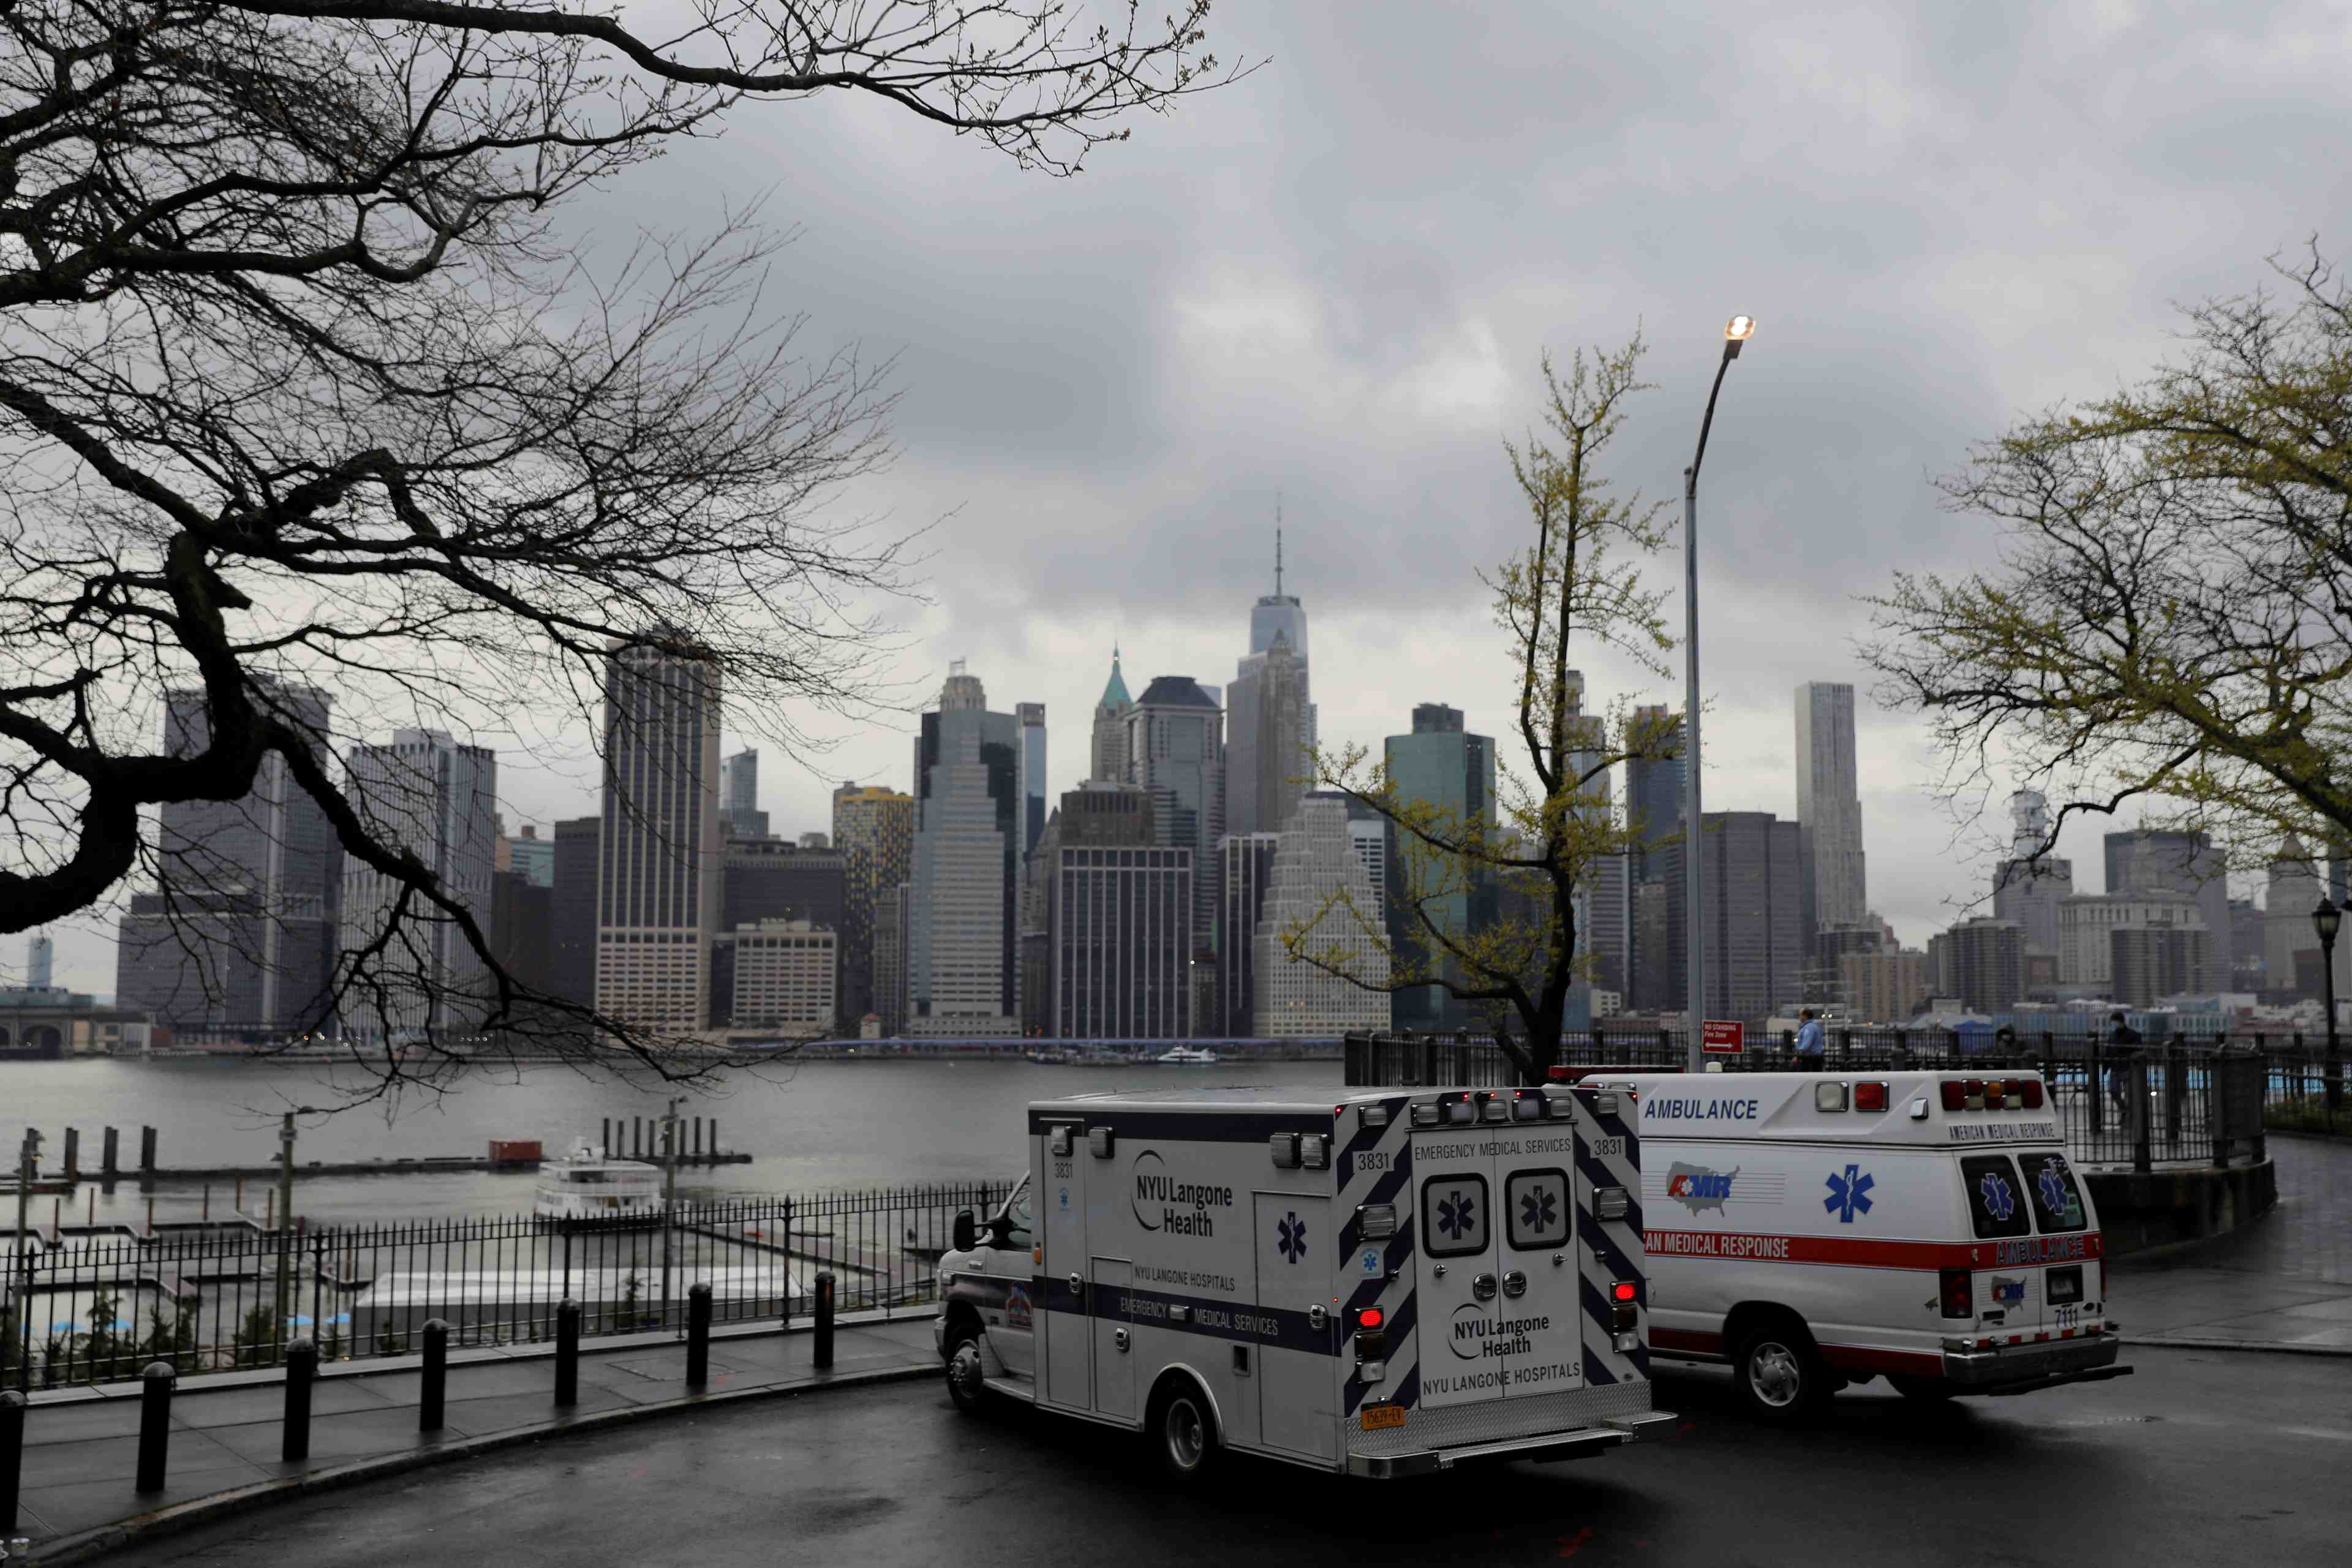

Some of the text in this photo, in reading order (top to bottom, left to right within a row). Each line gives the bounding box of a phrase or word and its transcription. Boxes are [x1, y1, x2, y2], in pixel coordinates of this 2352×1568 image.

[1645, 1099, 1758, 1119] AMBULANCE
[1949, 1122, 2055, 1140] AMERICAN MEDICAL RESPONSE
[1415, 1138, 1571, 1160] EMERGENCY MEDICAL SERVICES
[1594, 1139, 1621, 1155] 3831
[1055, 1163, 1073, 1178] 3831
[1359, 1153, 1389, 1170] 3831
[1137, 1175, 1232, 1210] NYU Langone
[1667, 1175, 1732, 1198] AMR
[1164, 1208, 1212, 1237] Health
[1665, 1234, 1718, 1254] MEDICAL
[1721, 1236, 1789, 1257] RESPONSE
[1997, 1236, 2085, 1264] AMBULANCE
[1135, 1265, 1235, 1292] NYU LANGONE HOSPITALS
[1120, 1297, 1278, 1335] EMERGENCY MEDICAL SERVICES
[2055, 1306, 2078, 1328] 7111
[1455, 1316, 1549, 1340] NYU Langone
[1483, 1336, 1531, 1357] Health
[1423, 1362, 1580, 1395] NYU LANGONE HOSPITALS
